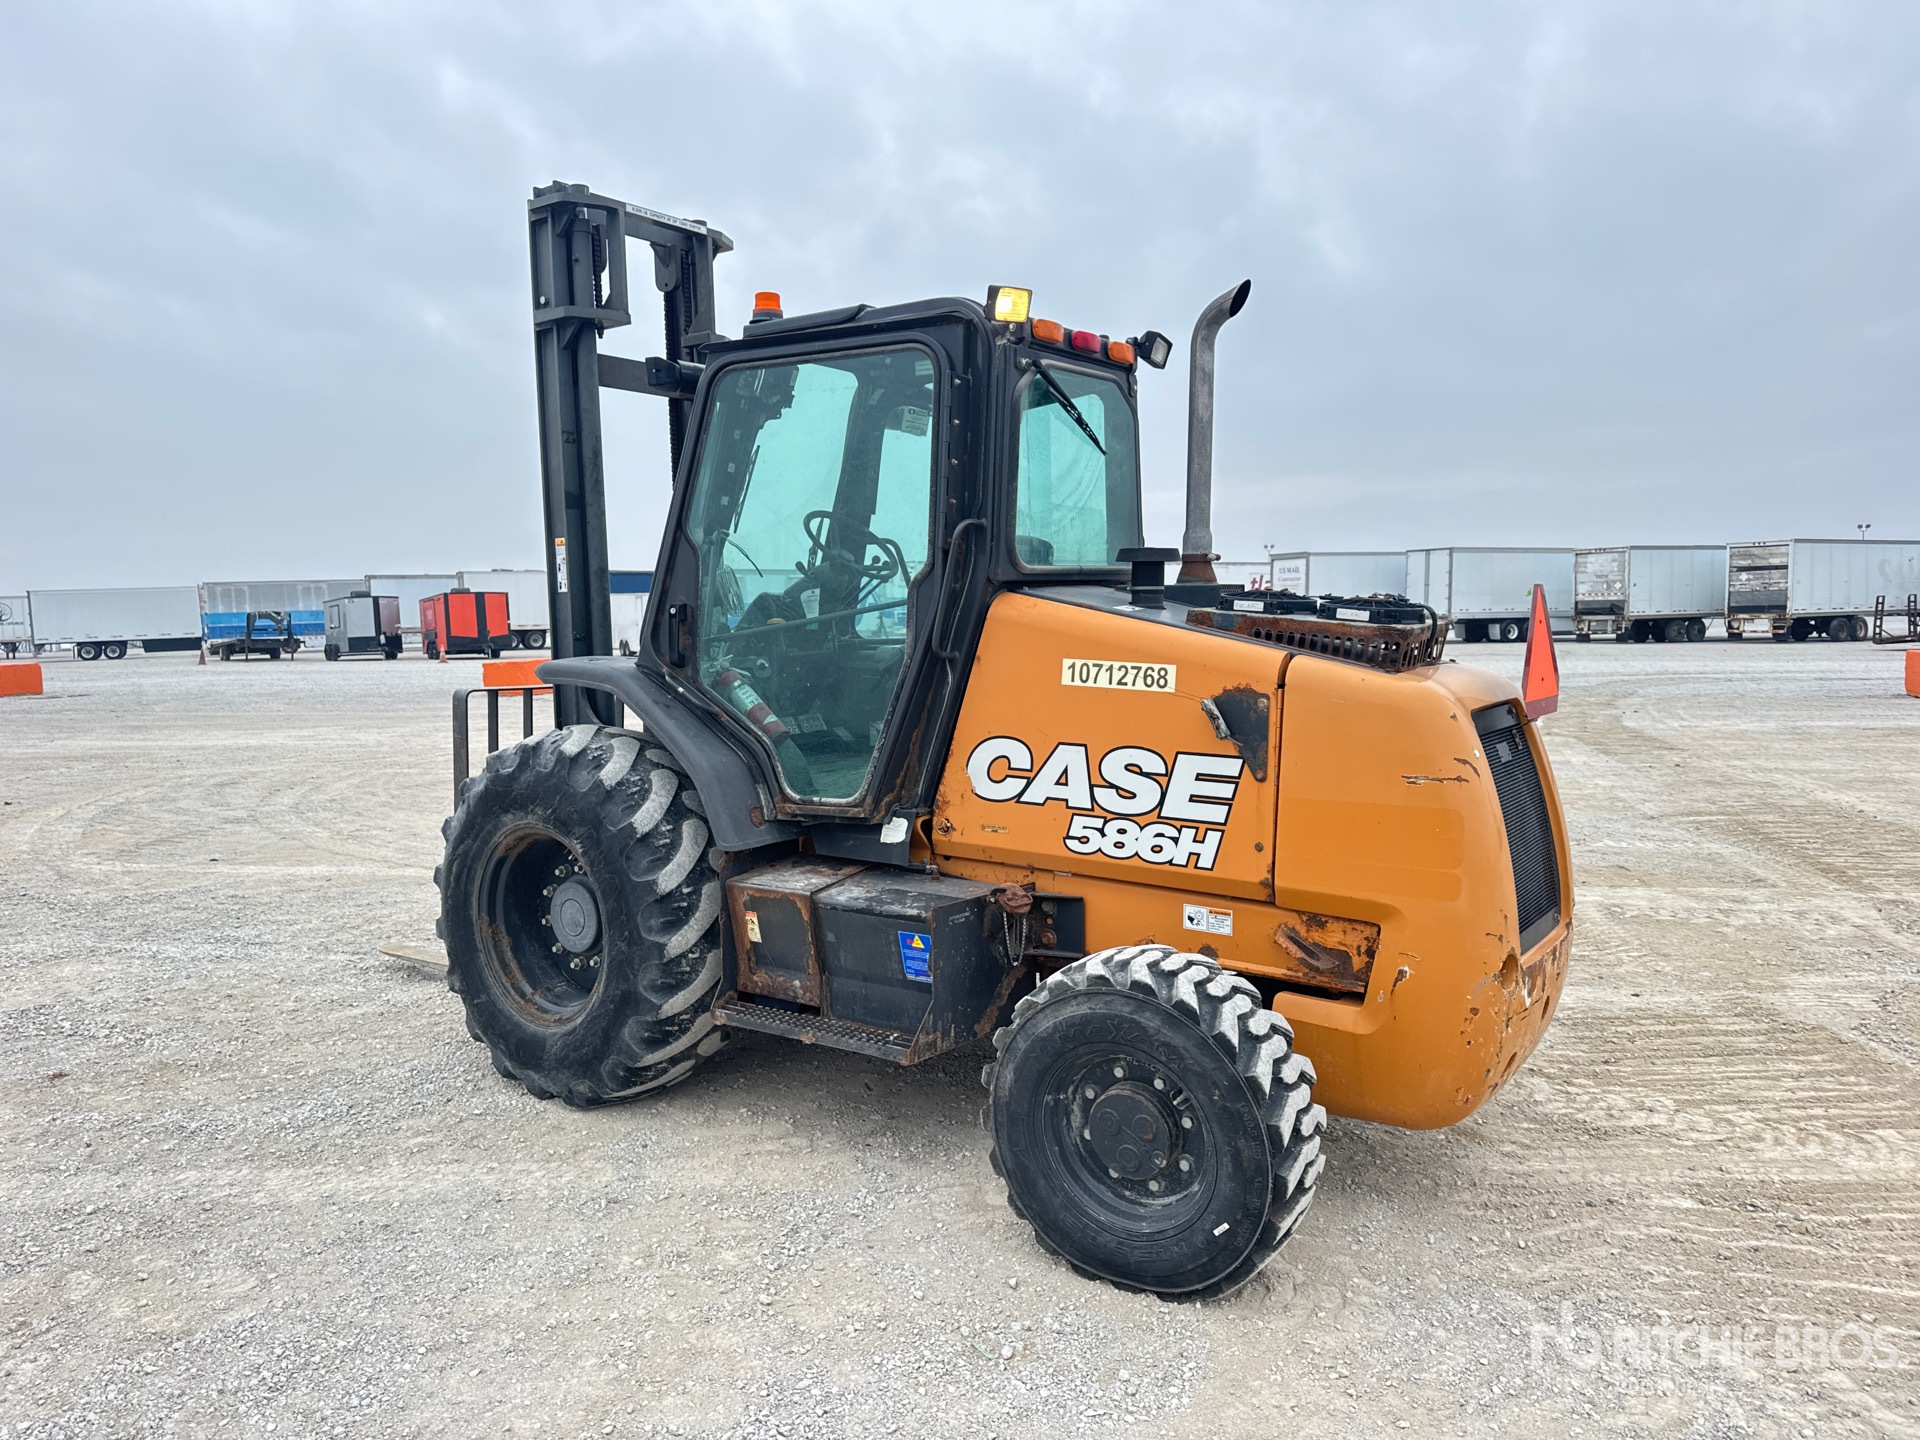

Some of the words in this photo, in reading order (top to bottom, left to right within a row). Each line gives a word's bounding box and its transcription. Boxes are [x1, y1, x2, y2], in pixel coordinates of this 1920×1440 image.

[1067, 662, 1169, 689] 10712768
[965, 736, 1245, 825] CASE
[1063, 814, 1225, 870] 586H
